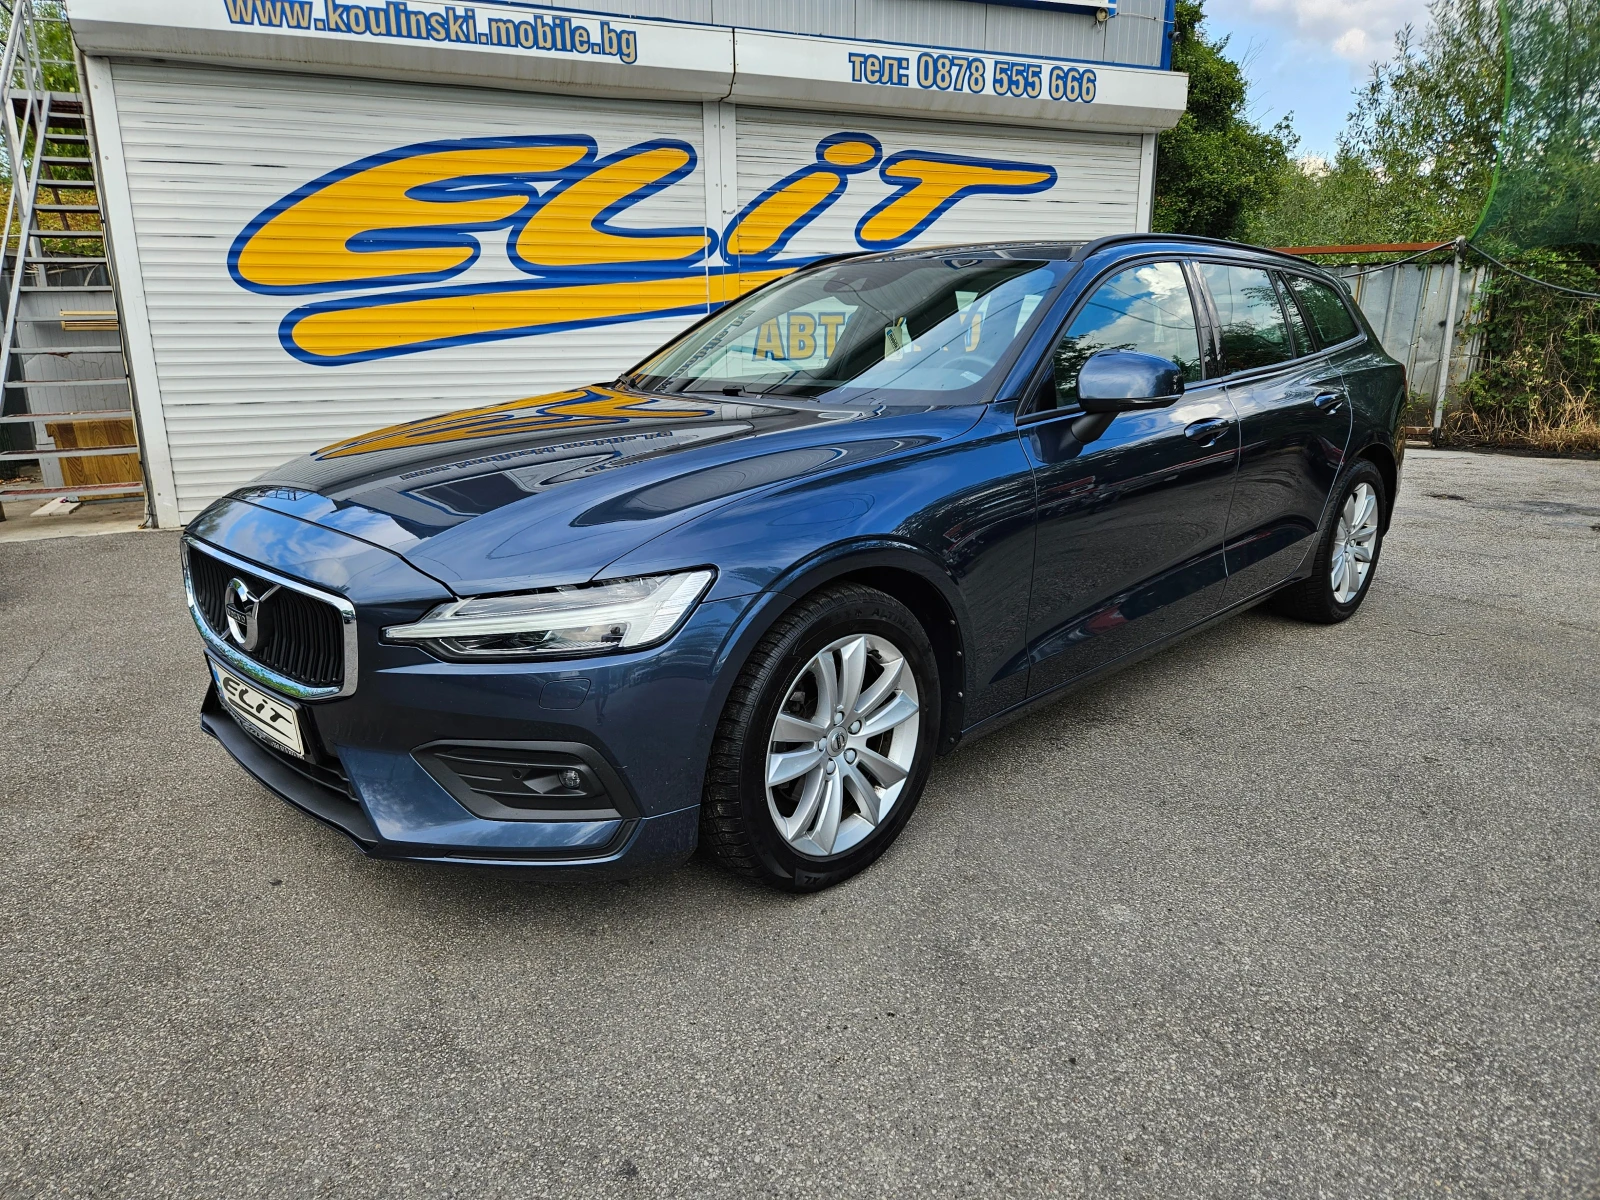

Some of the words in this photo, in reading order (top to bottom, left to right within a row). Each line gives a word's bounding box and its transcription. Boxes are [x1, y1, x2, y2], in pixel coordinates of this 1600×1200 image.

[224, 0, 637, 64] www.koulinski.mobile.bg
[916, 52, 985, 94] 0878
[993, 61, 1042, 98] 555
[1050, 66, 1096, 103] 666
[752, 312, 851, 361] АВТ
